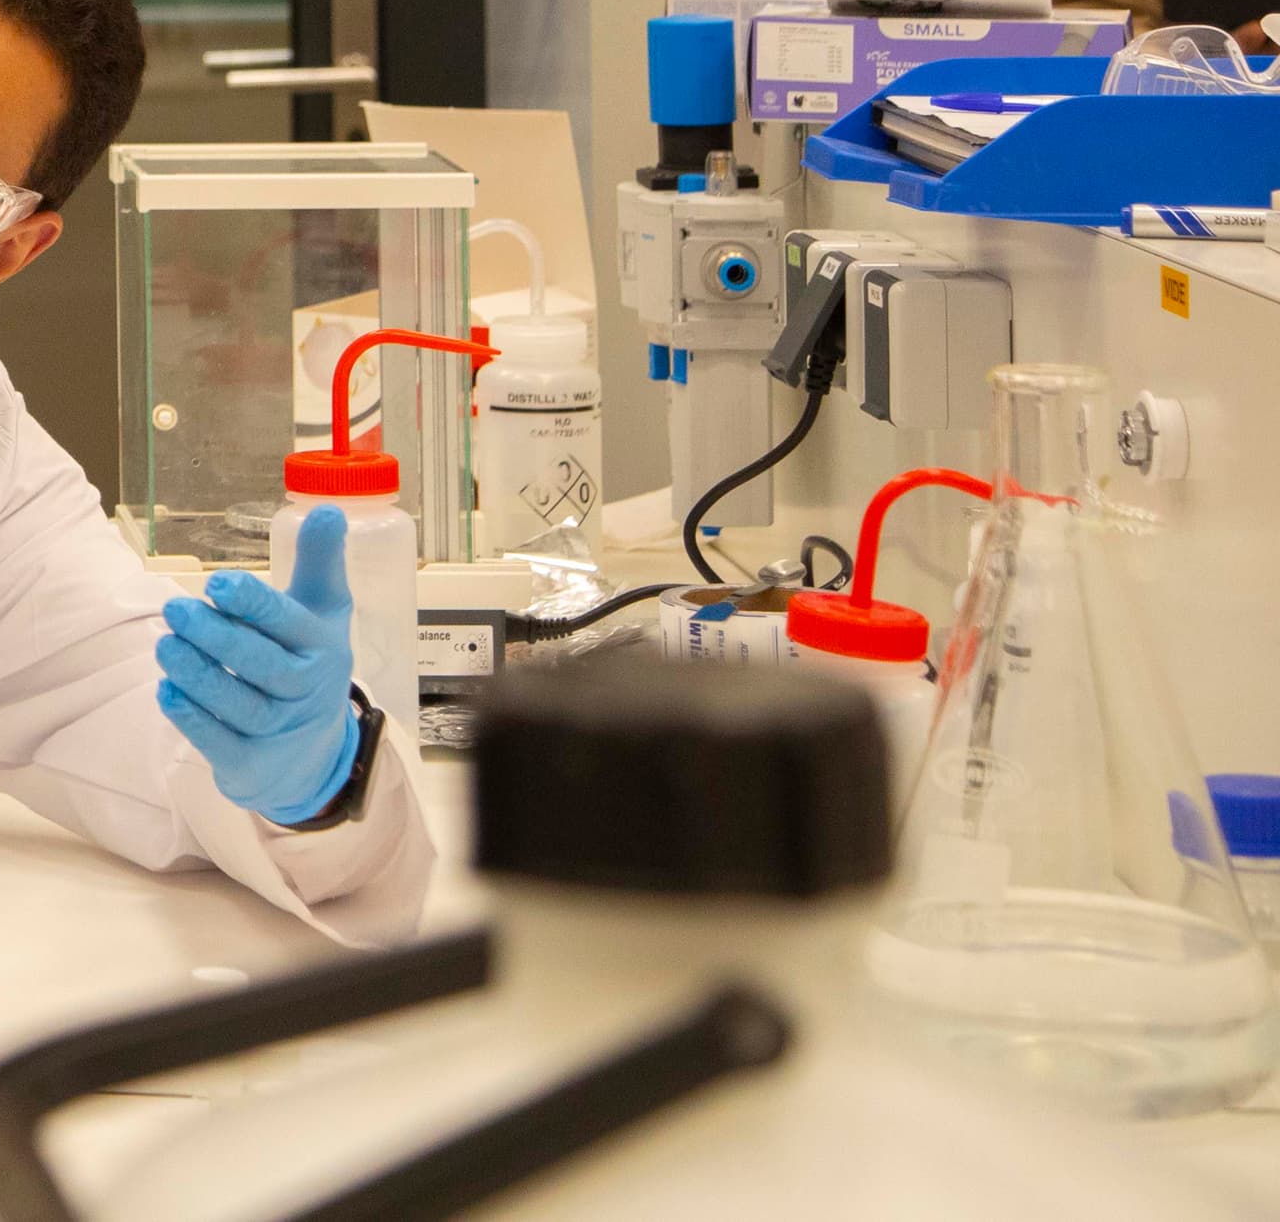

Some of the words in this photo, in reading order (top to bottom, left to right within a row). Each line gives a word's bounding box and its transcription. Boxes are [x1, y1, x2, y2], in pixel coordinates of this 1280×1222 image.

[903, 23, 965, 37] SMALL
[1164, 277, 1186, 305] VIDE
[416, 631, 451, 641] alance
